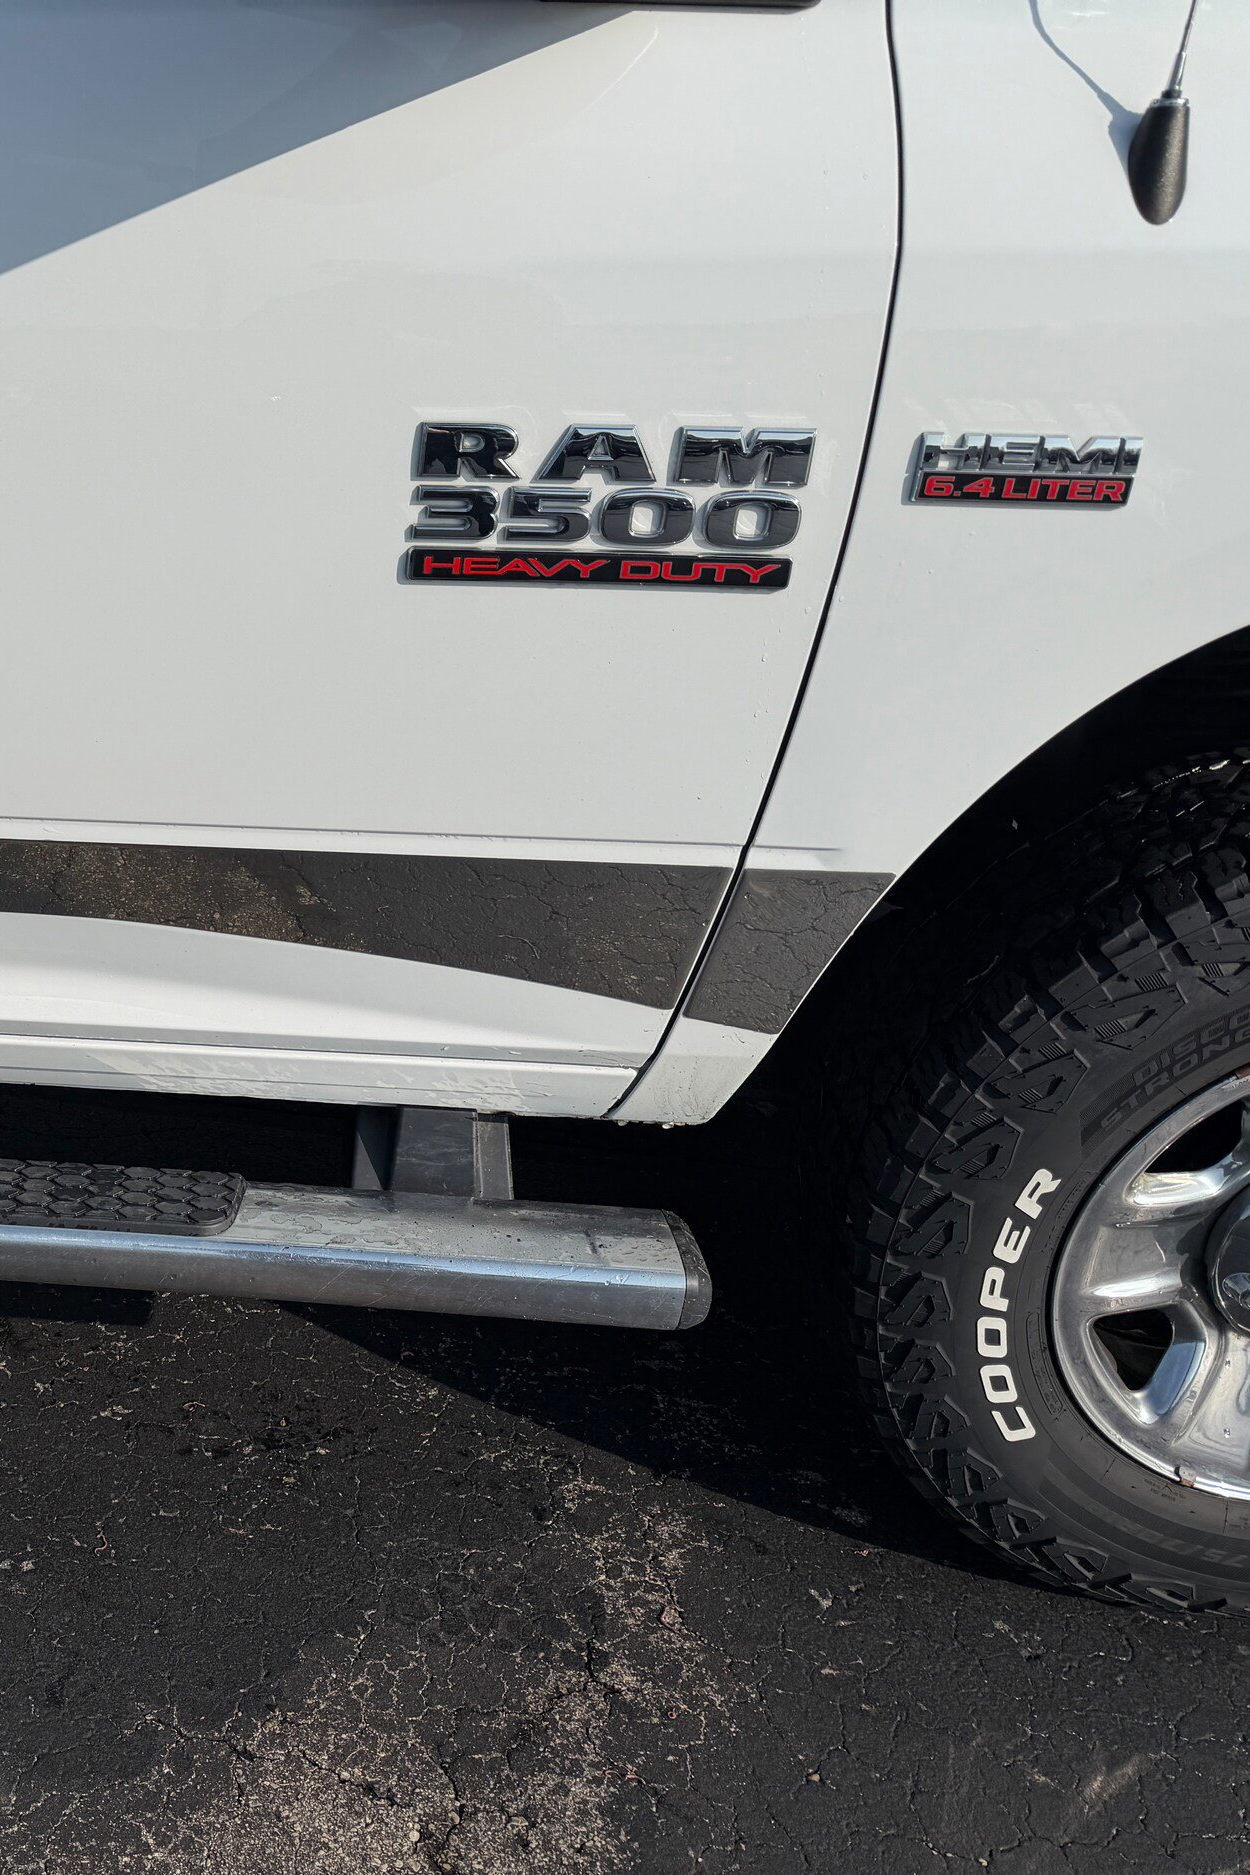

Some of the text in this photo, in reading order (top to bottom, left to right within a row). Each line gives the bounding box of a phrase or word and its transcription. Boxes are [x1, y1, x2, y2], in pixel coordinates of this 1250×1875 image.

[415, 421, 818, 487] RAM
[917, 431, 1144, 474] HEMI
[924, 475, 1127, 502] 6.4 LITER
[409, 484, 803, 548] 3500
[422, 555, 782, 583] HEAVY DUTY
[976, 1167, 1062, 1442] COOPER
